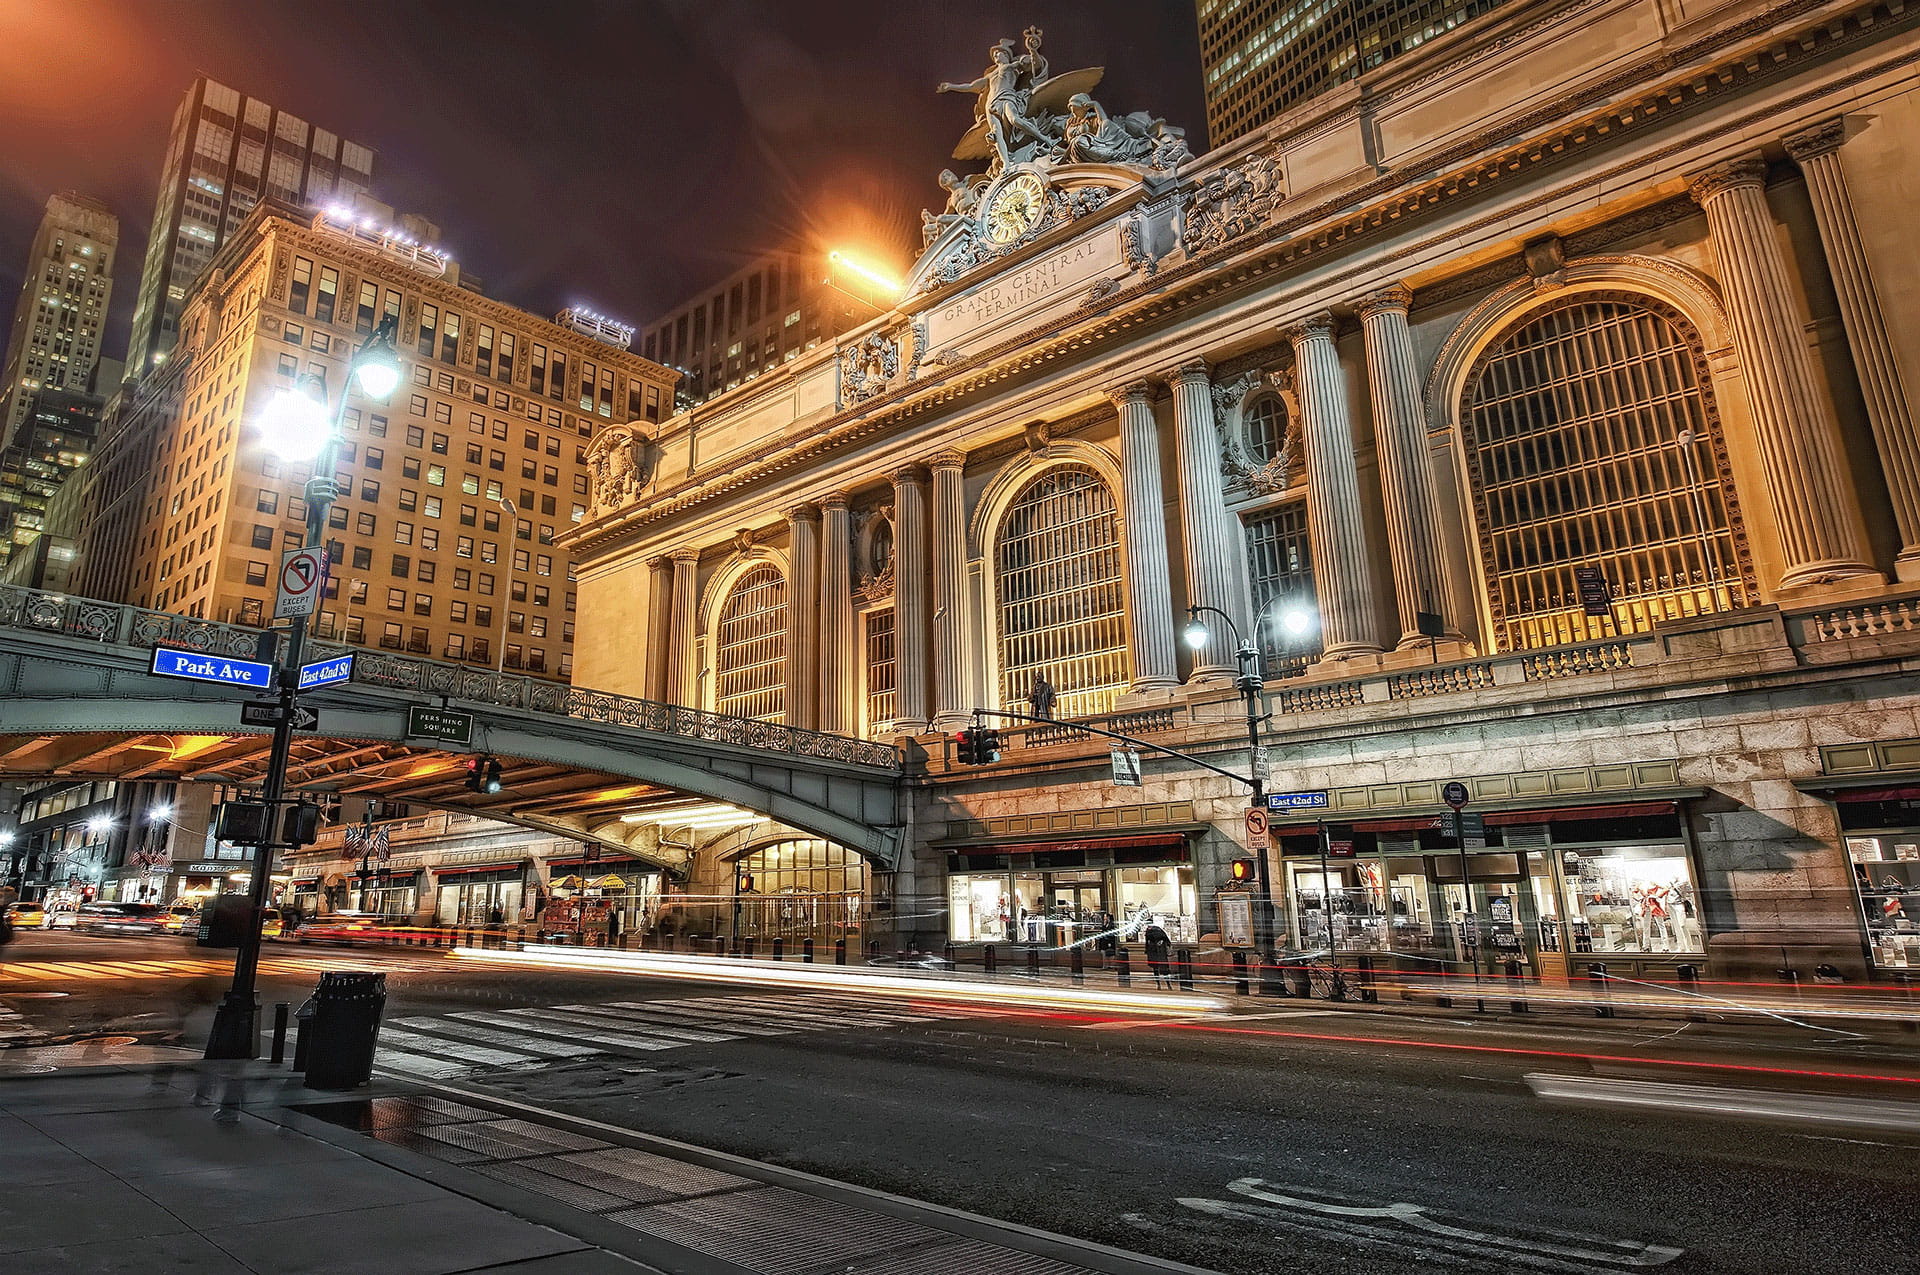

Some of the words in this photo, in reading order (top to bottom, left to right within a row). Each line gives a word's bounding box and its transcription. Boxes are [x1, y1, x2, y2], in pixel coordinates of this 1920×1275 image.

[944, 288, 1000, 321] GRAND
[1012, 243, 1096, 289] CENTRAL
[975, 274, 1060, 321] TERMINAL
[282, 596, 309, 606] EXCEPT
[283, 605, 306, 614] BUSES
[174, 657, 217, 676] Park
[219, 664, 252, 681] Ave
[302, 669, 320, 684] East
[319, 664, 338, 681] 42nd
[336, 662, 350, 676] St
[252, 709, 274, 719] ONE
[423, 724, 457, 734] SQUARE
[1272, 798, 1290, 806] East
[1291, 796, 1312, 805] 42nd
[1313, 795, 1324, 804] St
